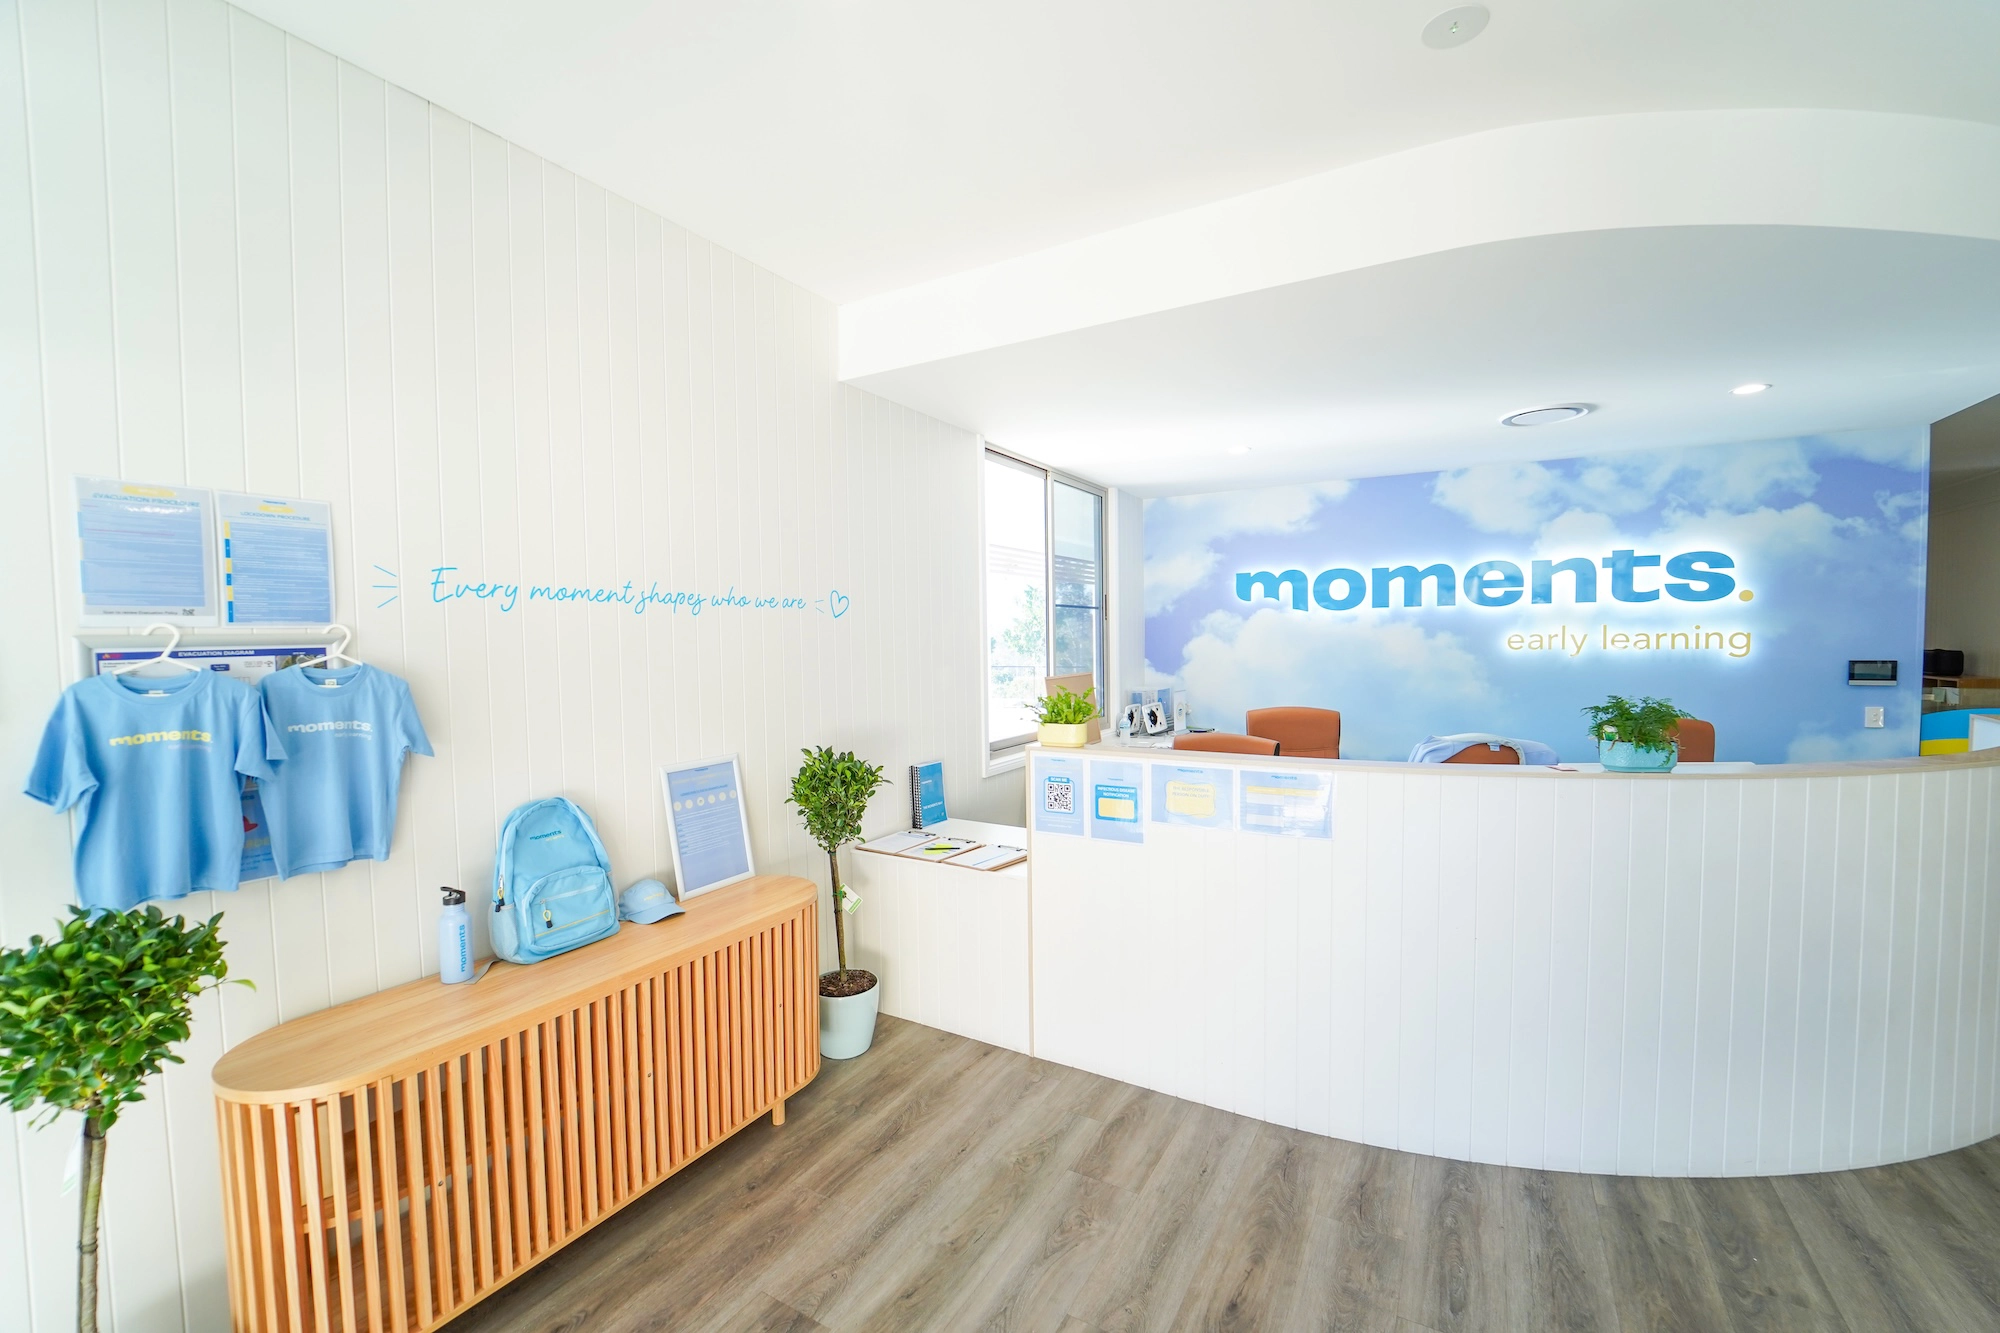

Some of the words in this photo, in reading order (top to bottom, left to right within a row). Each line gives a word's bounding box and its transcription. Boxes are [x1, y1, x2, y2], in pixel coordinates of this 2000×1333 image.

[92, 493, 150, 503] EVACUATION
[431, 567, 518, 612] Every
[529, 580, 635, 605] moment
[634, 581, 707, 616] shapes
[711, 586, 751, 607] who
[755, 597, 779, 608] we
[781, 596, 806, 609] are
[1235, 549, 1754, 612] moments.
[1506, 625, 1588, 657] early
[1602, 624, 1752, 658] learning
[529, 830, 562, 840] moments
[459, 924, 467, 973] moments
